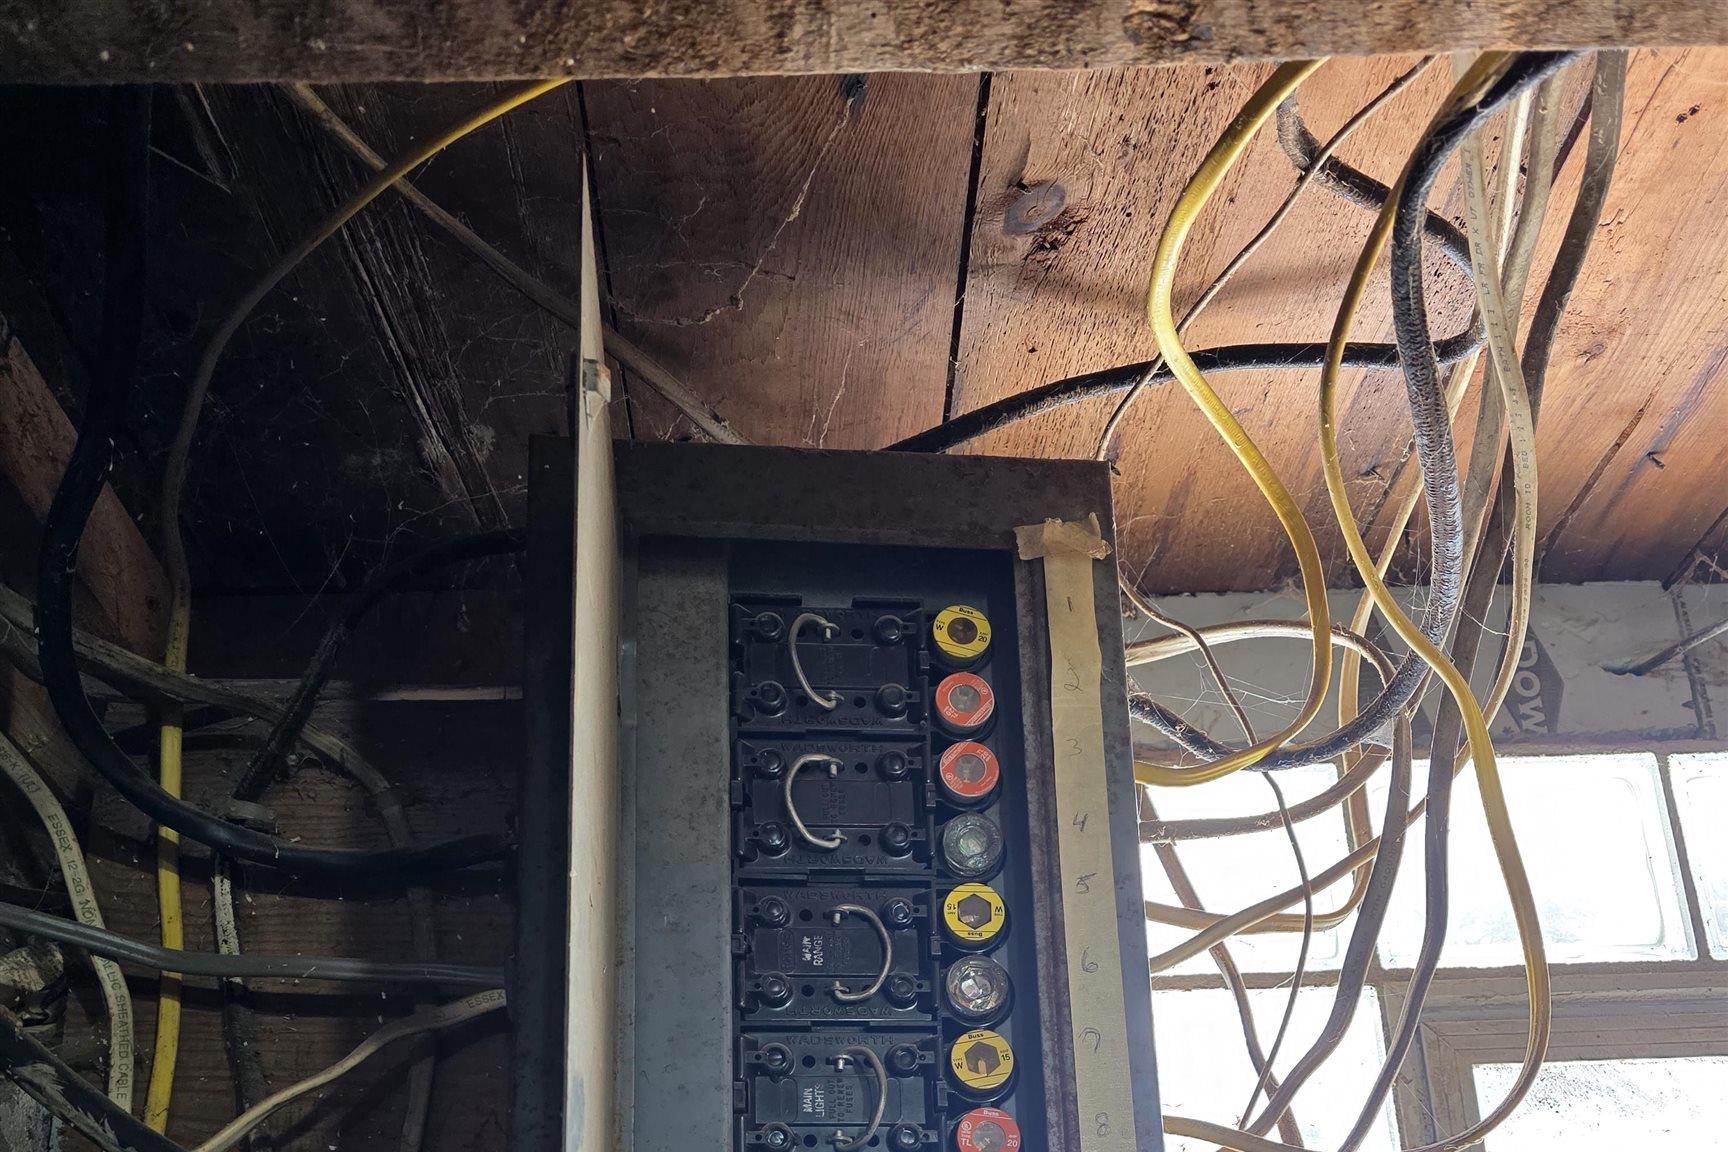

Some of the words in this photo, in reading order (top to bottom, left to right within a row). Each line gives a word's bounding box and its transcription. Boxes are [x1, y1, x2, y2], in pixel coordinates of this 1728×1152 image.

[1066, 738, 1083, 757] 3
[1072, 811, 1088, 832] 4
[48, 813, 73, 853] ESSEX
[1075, 872, 1098, 894] 5
[812, 935, 824, 966] RANGE
[1081, 946, 1099, 974] 6
[464, 990, 505, 1009] ESSEX
[114, 995, 129, 1058] SHEATHED
[967, 1032, 985, 1040] Buss
[954, 1062, 964, 1070] W
[1001, 1053, 1011, 1063] 15
[116, 1062, 129, 1100] CABLE
[802, 1088, 813, 1113] MAIN
[983, 1109, 1000, 1117] Buss
[1095, 1111, 1111, 1137] 8
[961, 1138, 973, 1147] TL
[1007, 1139, 1018, 1148] 20
